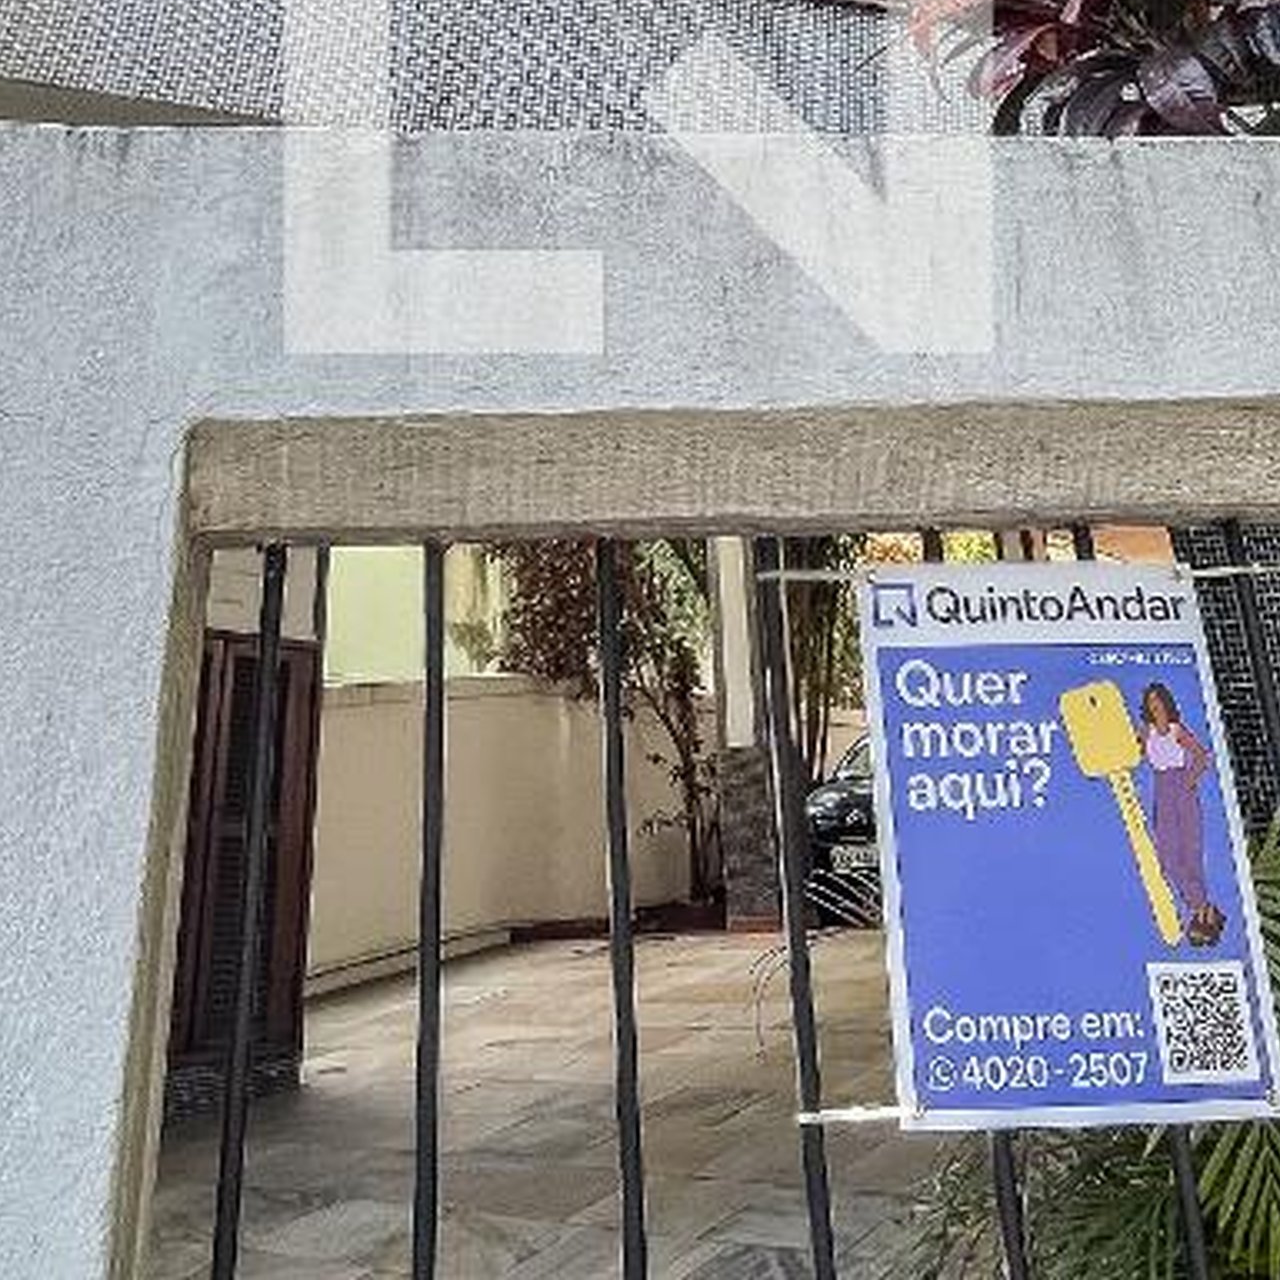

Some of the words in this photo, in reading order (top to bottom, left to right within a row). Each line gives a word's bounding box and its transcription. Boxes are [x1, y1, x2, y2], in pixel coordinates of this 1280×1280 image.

[925, 583, 1187, 624] QuintoAndar
[894, 658, 1028, 708] Quer
[900, 718, 1059, 758] morar
[907, 758, 1052, 819] aqui?
[922, 1006, 1072, 1051] Compre
[1080, 1009, 1146, 1039] em:
